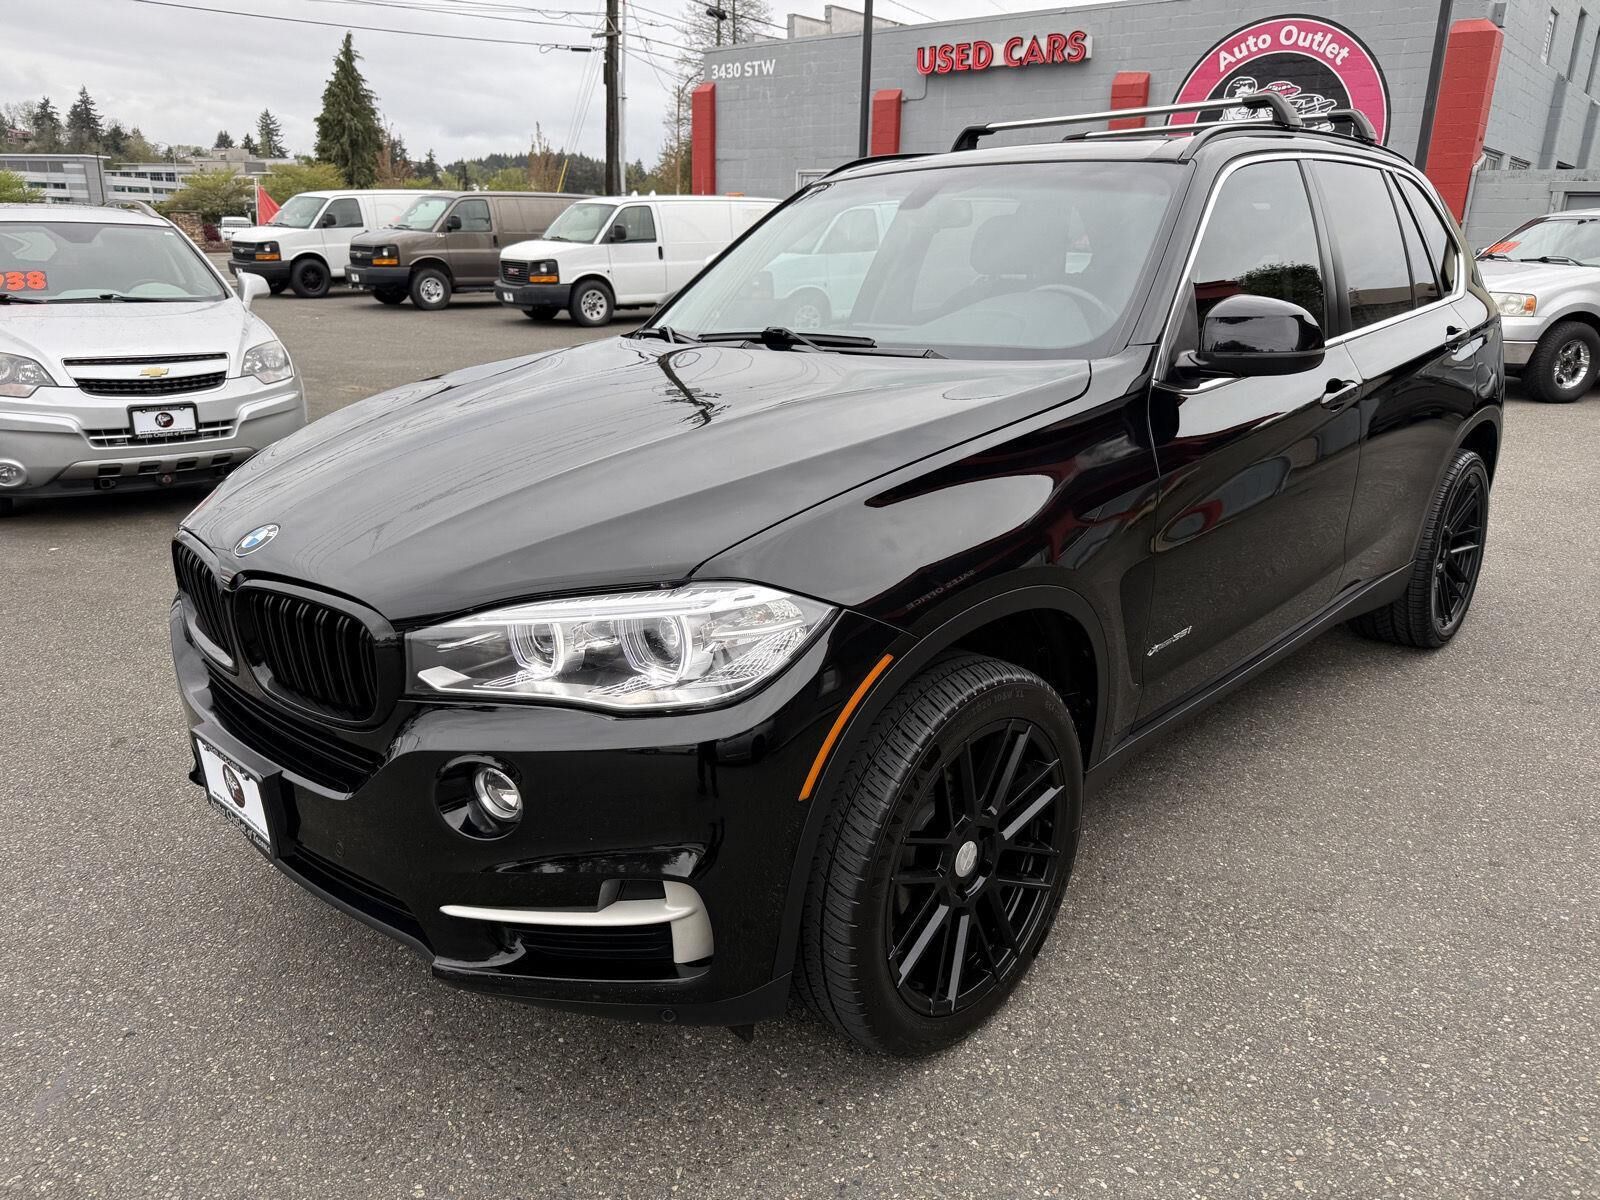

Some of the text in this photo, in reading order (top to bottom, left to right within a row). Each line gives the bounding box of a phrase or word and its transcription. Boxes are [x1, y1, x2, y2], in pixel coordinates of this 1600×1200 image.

[916, 30, 1088, 76] USED CARS
[1218, 25, 1350, 73] Auto Outlet
[711, 59, 776, 80] 3430 STW
[0, 271, 47, 291] 38
